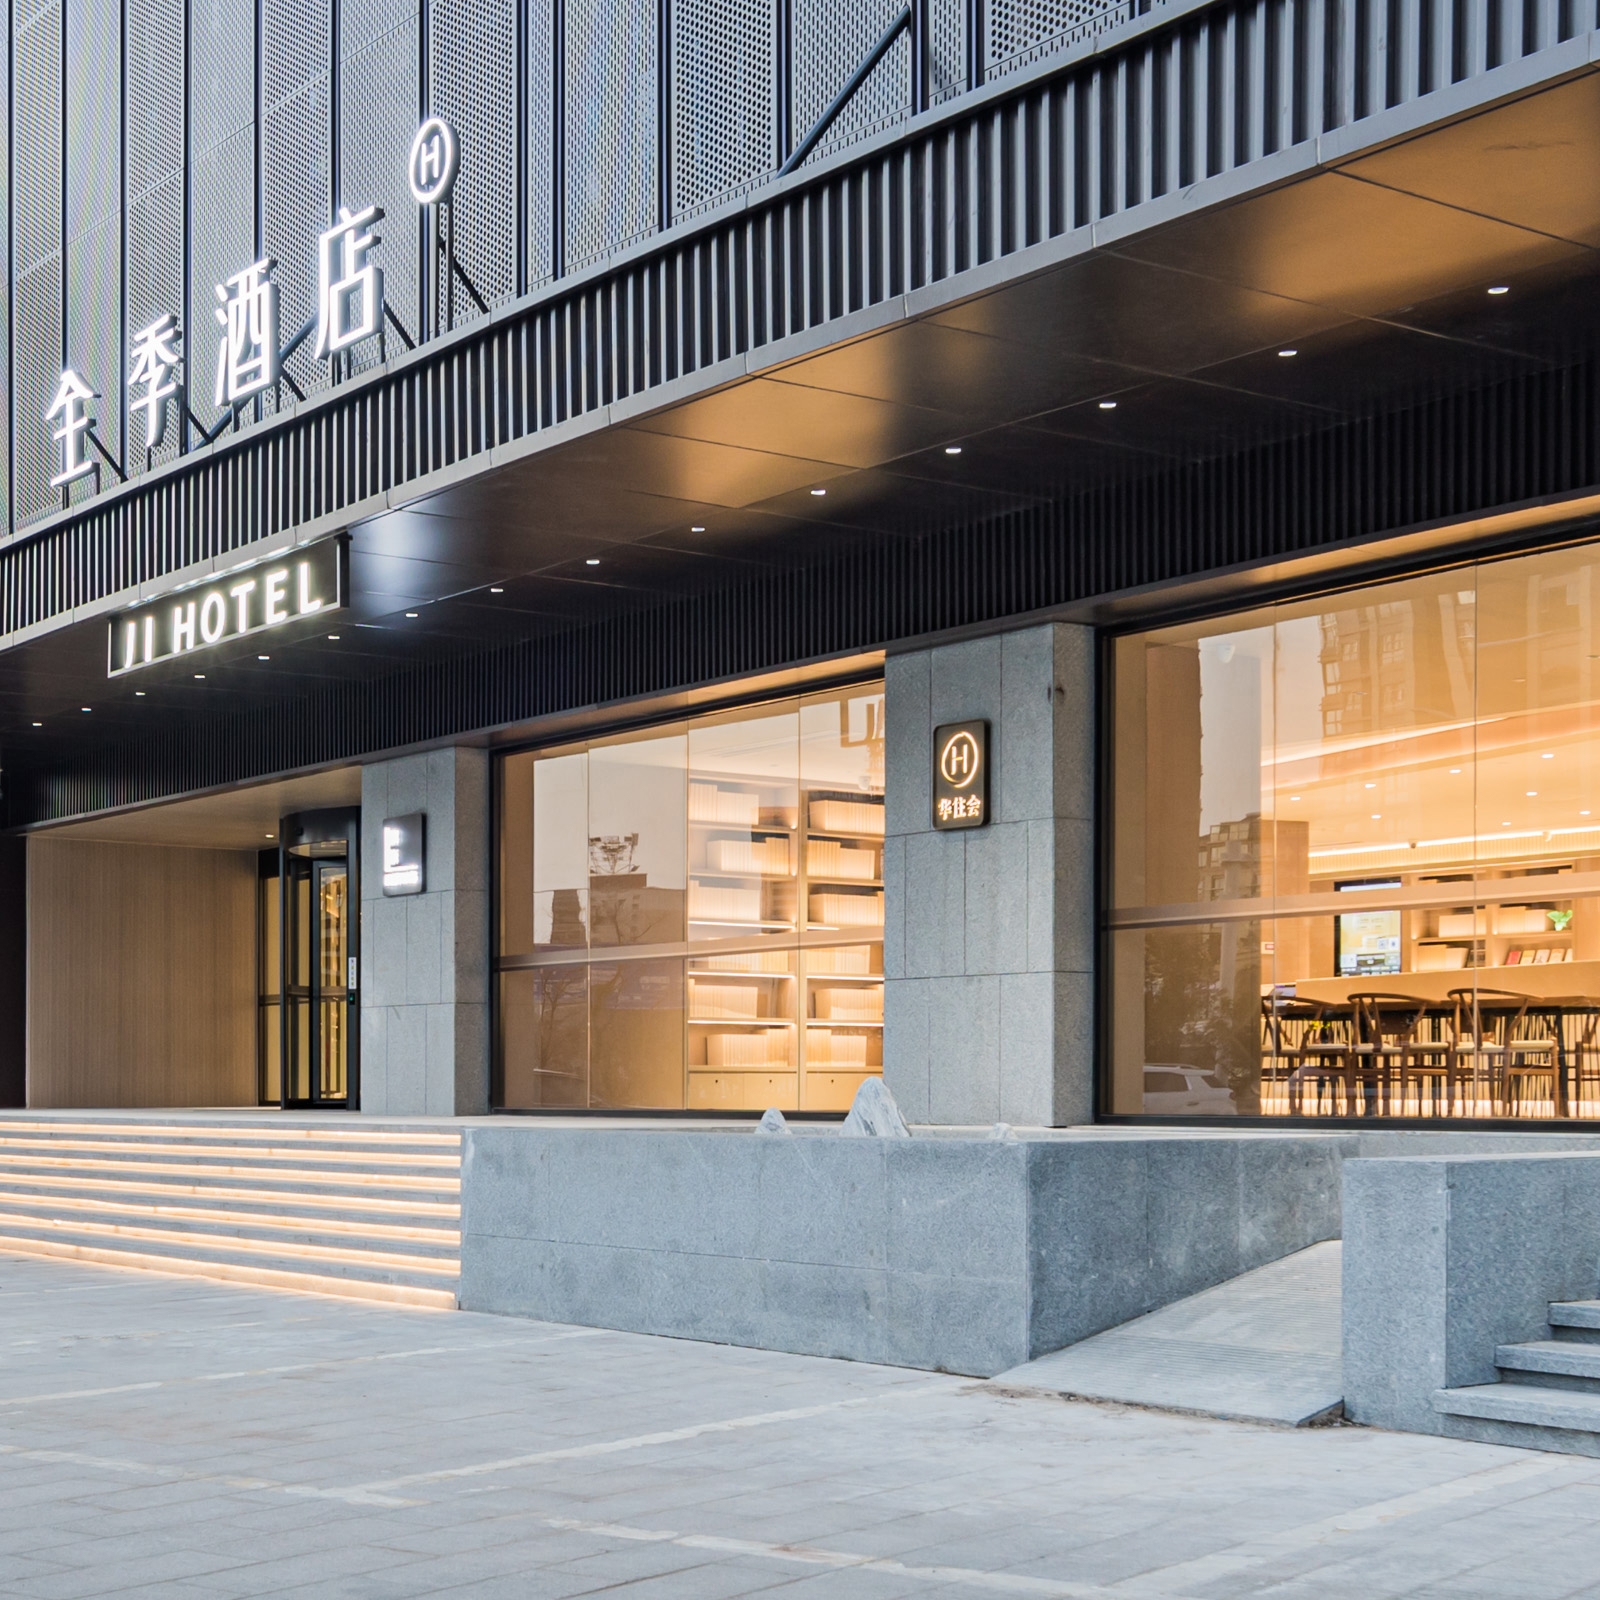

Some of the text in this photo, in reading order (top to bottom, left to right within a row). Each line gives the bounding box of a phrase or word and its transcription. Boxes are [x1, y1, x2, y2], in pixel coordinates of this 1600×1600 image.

[46, 204, 381, 487] 全季酒店
[124, 562, 322, 669] JI HOTEL
[937, 793, 982, 822] 华住会
